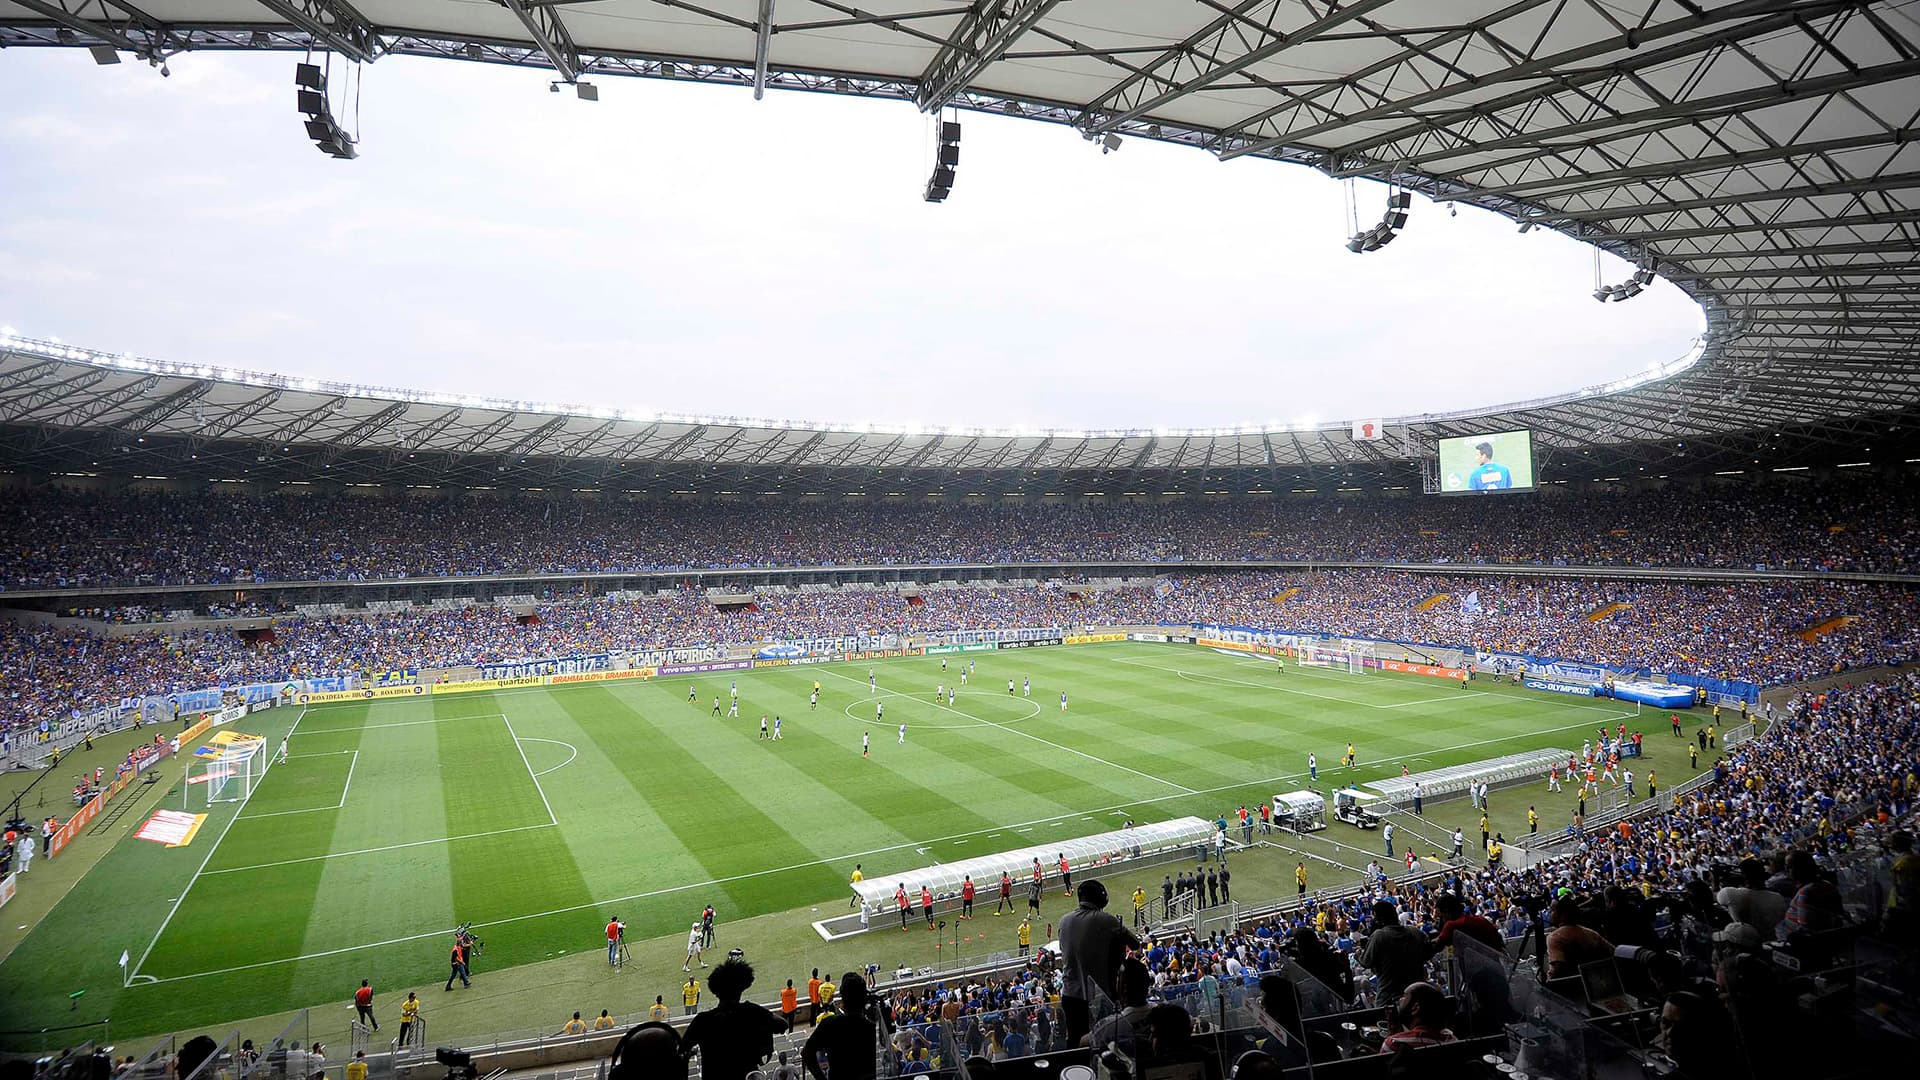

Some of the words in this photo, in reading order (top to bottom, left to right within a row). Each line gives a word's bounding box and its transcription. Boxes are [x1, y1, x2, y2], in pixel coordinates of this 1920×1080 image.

[679, 665, 696, 673] TUDO
[497, 676, 539, 687] quartzolit
[552, 674, 583, 684] BRAHMA
[605, 671, 634, 680] BRAHMA
[1547, 683, 1591, 695] OLYMPIKUS
[252, 700, 271, 713] IGUAIS
[221, 708, 240, 722] SOMOS
[1247, 968, 1257, 978] 10
